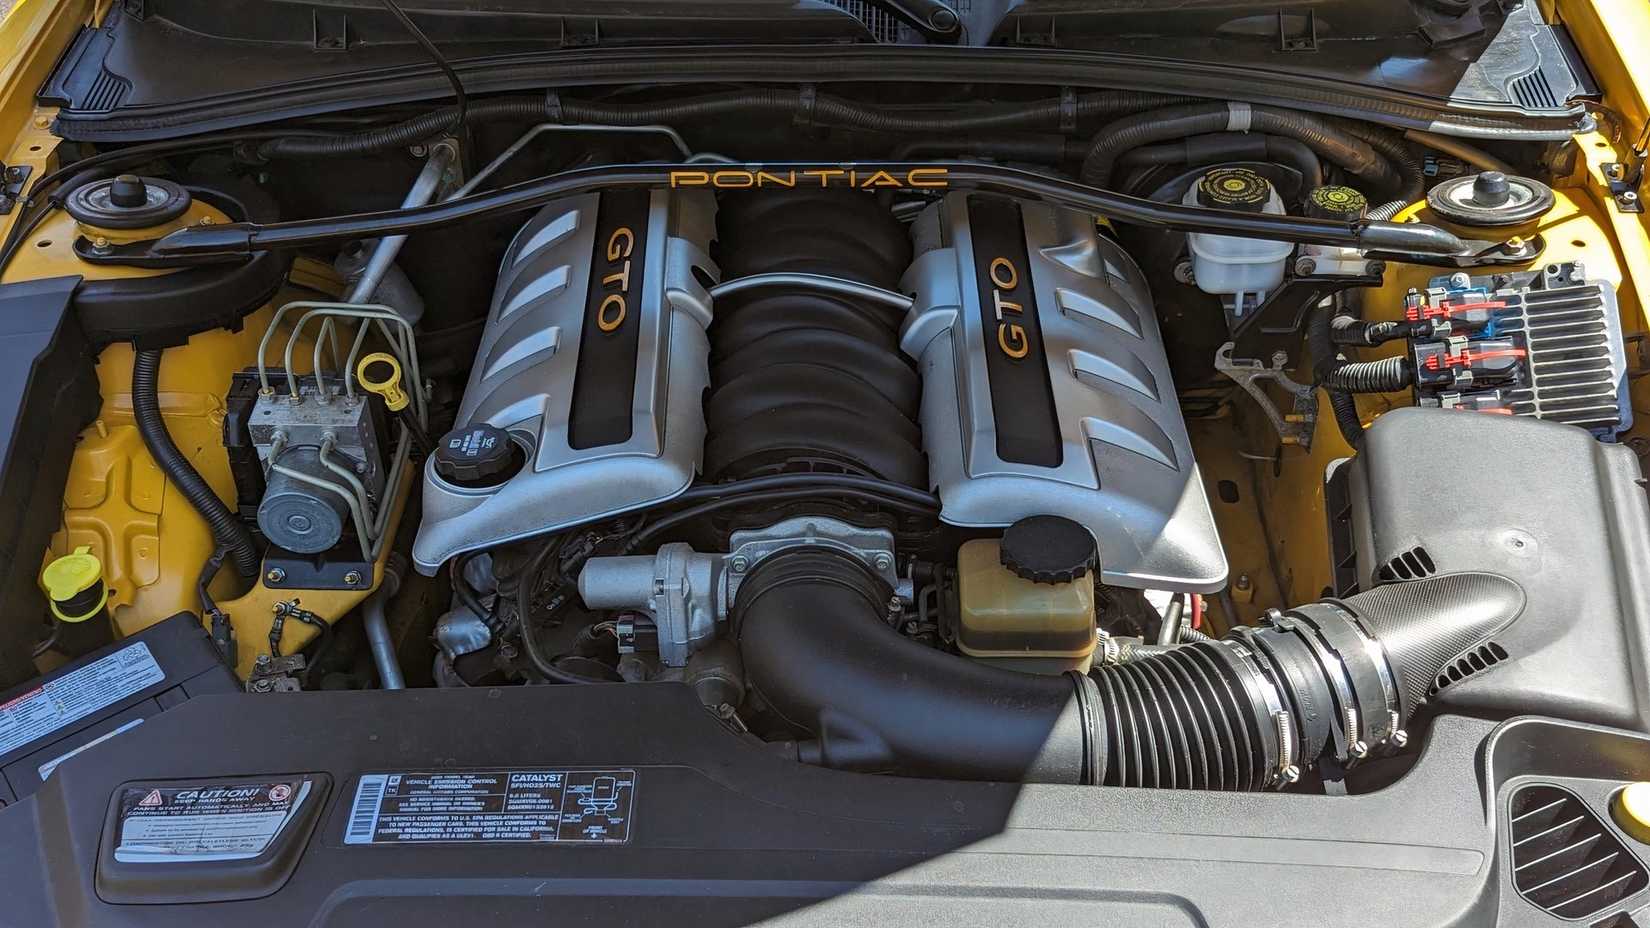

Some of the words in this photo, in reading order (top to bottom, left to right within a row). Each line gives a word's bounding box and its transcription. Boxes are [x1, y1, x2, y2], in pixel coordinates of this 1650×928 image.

[670, 169, 949, 188] PONTIAC
[598, 226, 635, 333] GTO
[989, 256, 1029, 359] GTO
[511, 774, 564, 783] CATALYST
[176, 788, 260, 799] CAUTION!
